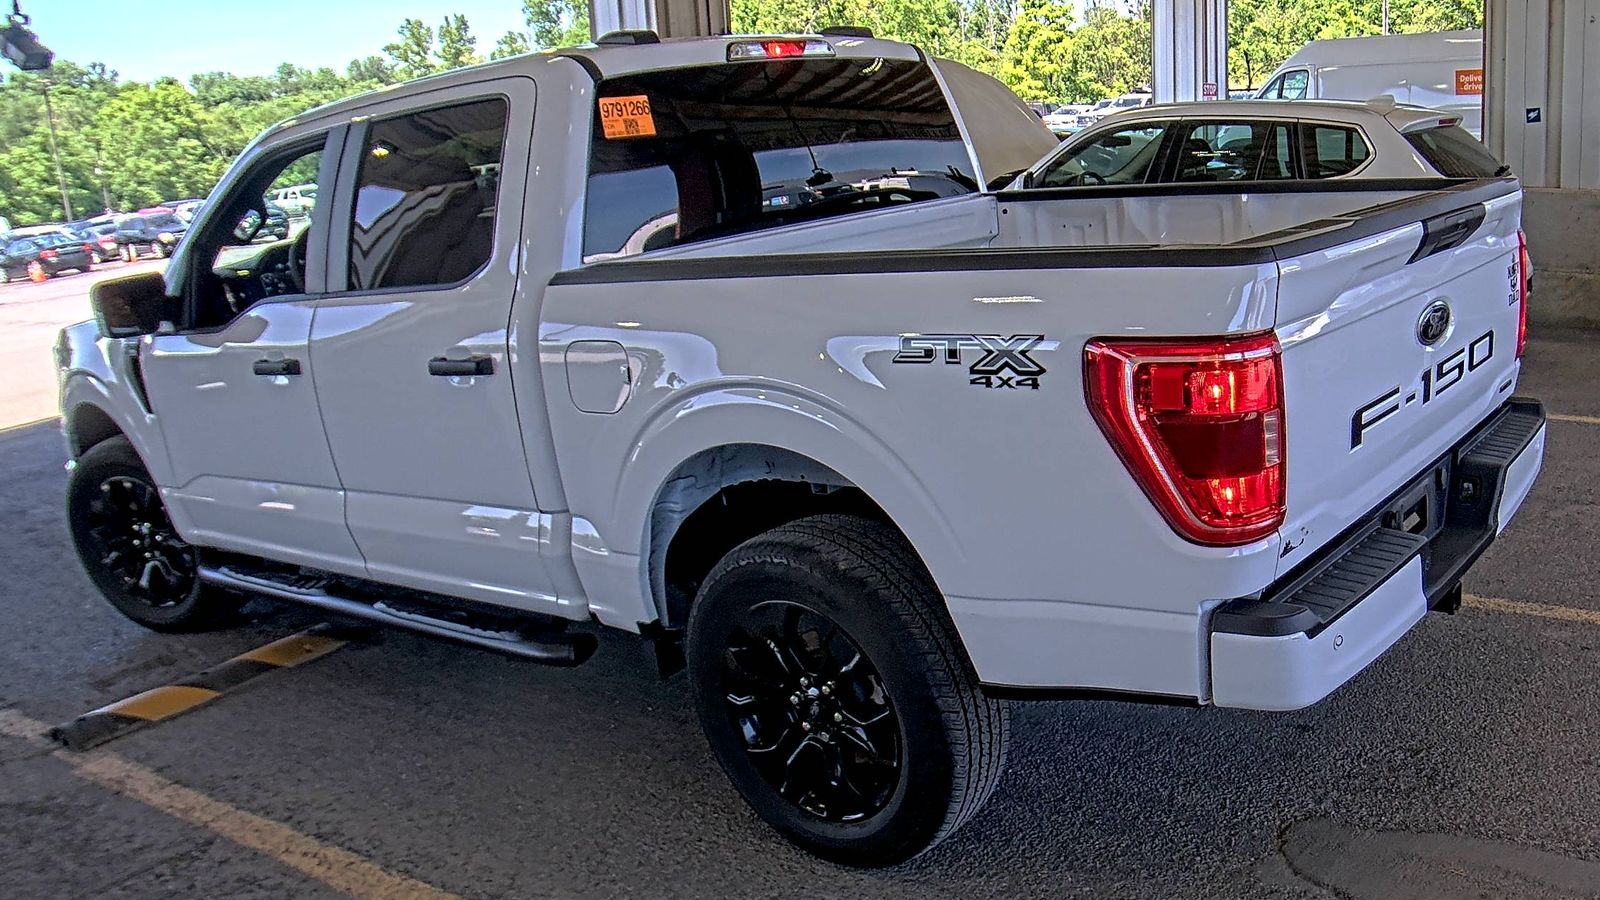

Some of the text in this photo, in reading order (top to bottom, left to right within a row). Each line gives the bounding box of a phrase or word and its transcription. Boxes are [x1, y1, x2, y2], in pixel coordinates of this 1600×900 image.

[1203, 84, 1217, 96] STOP
[602, 100, 650, 118] 9791266
[892, 333, 1047, 377] STX
[1350, 329, 1495, 451] F-150
